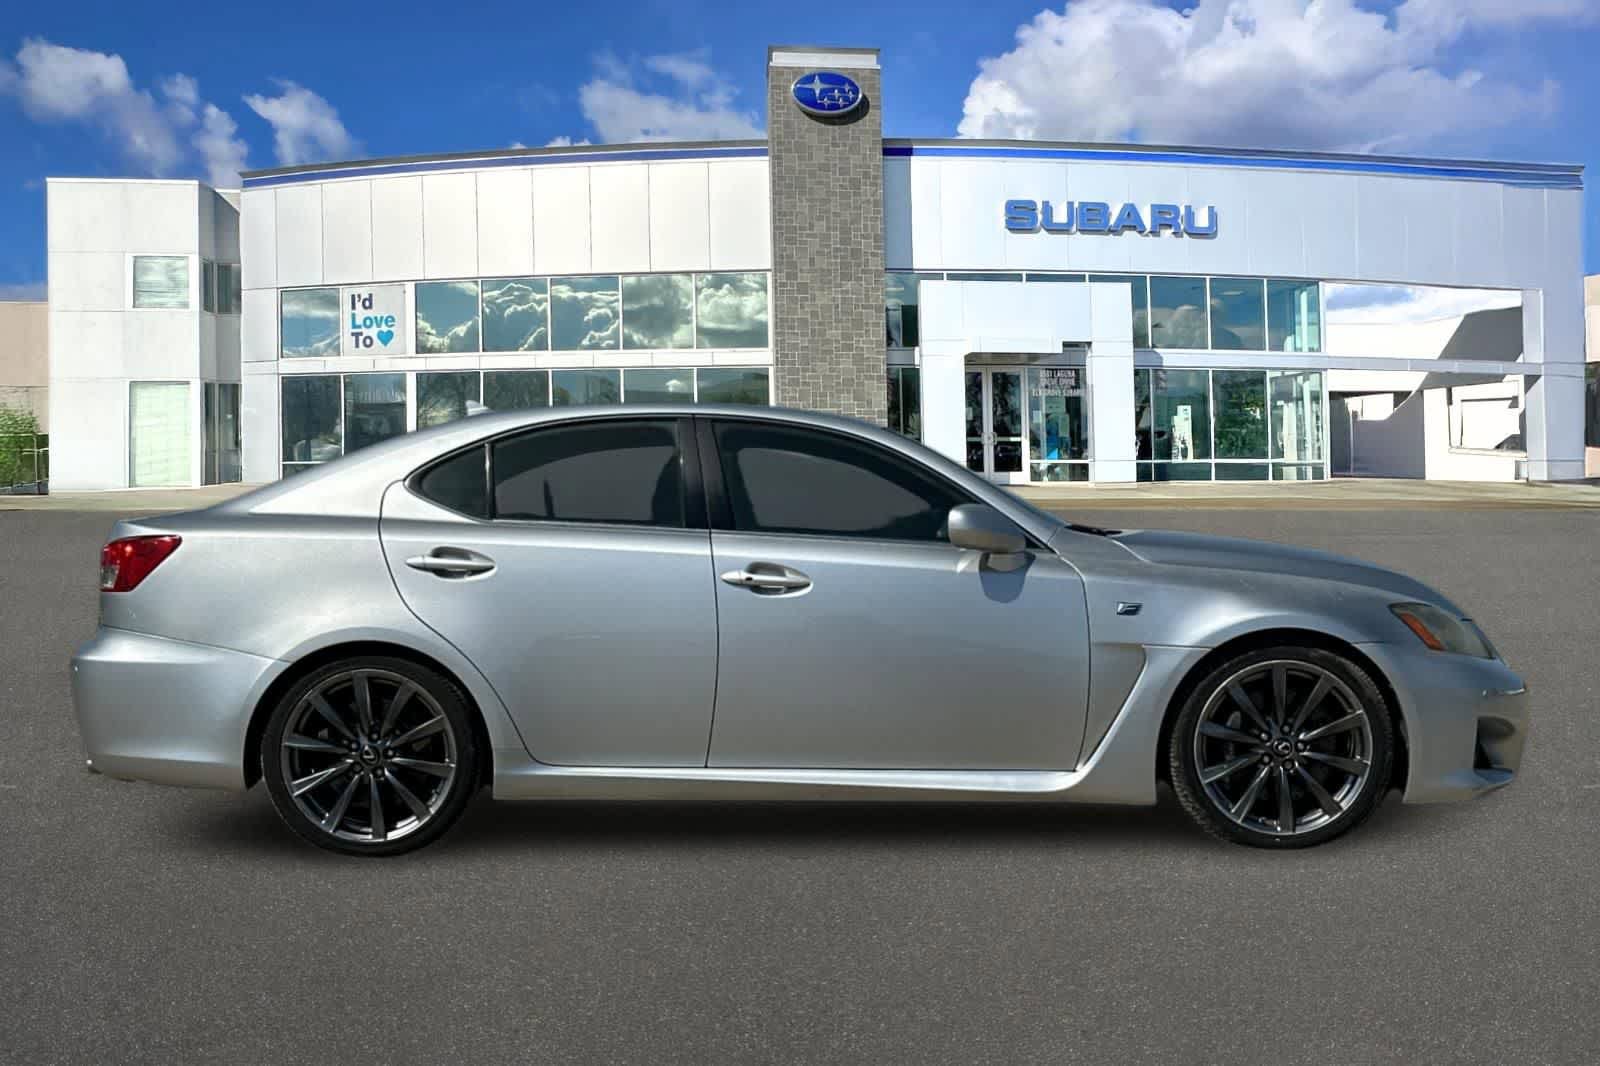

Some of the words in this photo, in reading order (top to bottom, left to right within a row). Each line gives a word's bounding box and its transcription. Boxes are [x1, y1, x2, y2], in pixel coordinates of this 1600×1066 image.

[1005, 199, 1217, 239] SUBARU
[351, 312, 396, 329] Love
[351, 331, 374, 349] To
